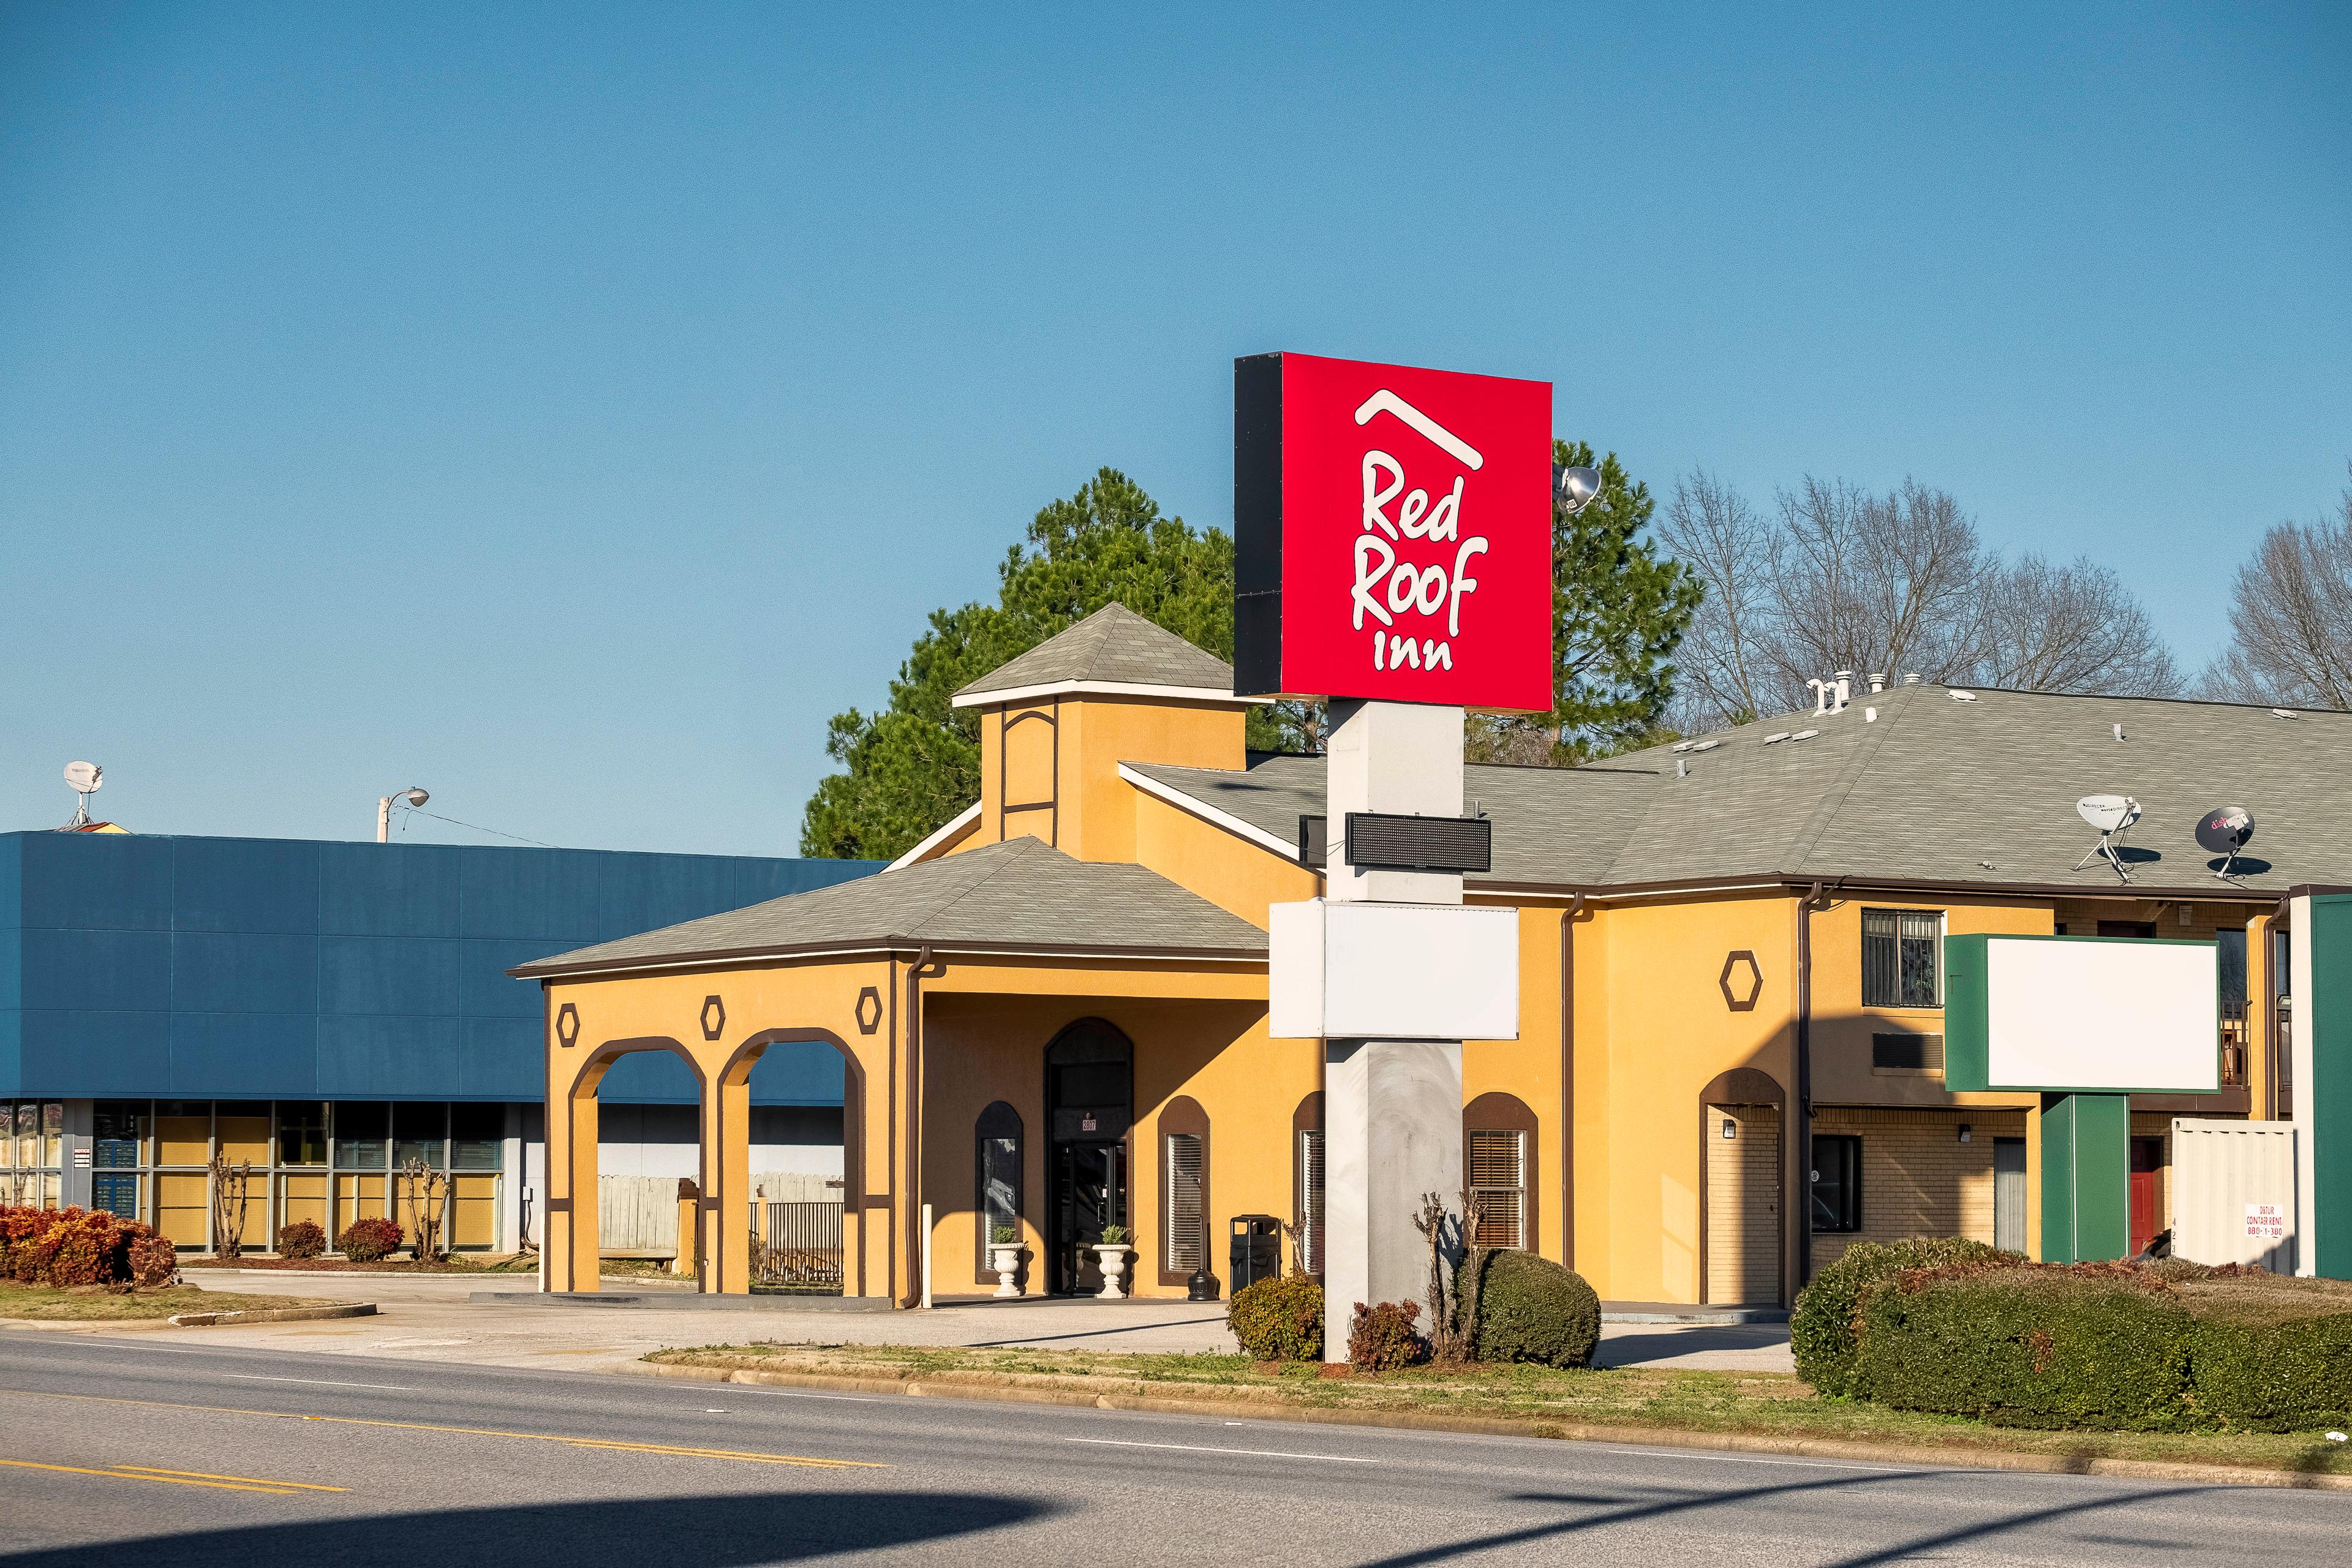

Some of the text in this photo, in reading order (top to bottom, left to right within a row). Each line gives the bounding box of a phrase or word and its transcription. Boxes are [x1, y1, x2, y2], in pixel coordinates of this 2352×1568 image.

[1362, 450, 1464, 543] Red
[1351, 533, 1489, 638] Roof
[1084, 1121, 1095, 1129] 2807
